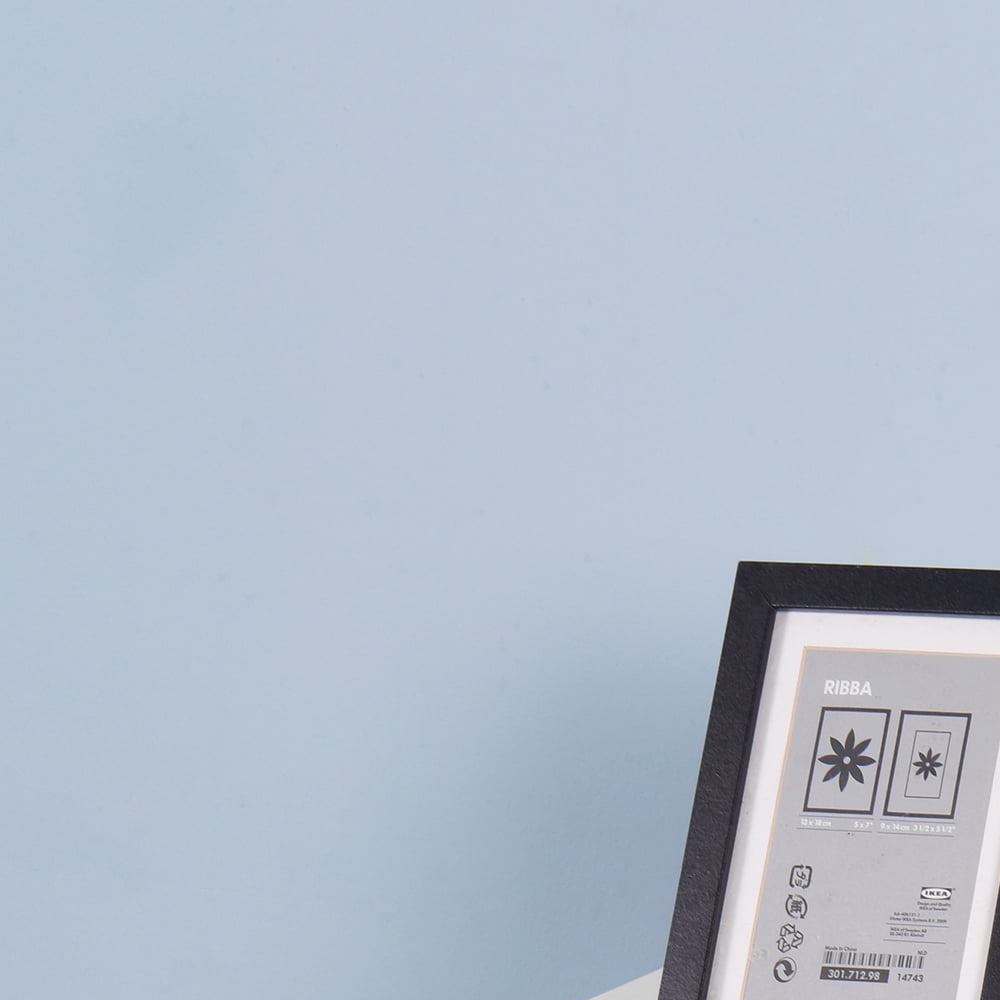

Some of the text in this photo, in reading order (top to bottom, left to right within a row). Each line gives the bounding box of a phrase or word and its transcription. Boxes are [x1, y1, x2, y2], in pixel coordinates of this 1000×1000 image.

[824, 680, 872, 696] RIBBA
[827, 969, 880, 981] 301.712.98
[897, 973, 924, 983] 14743
